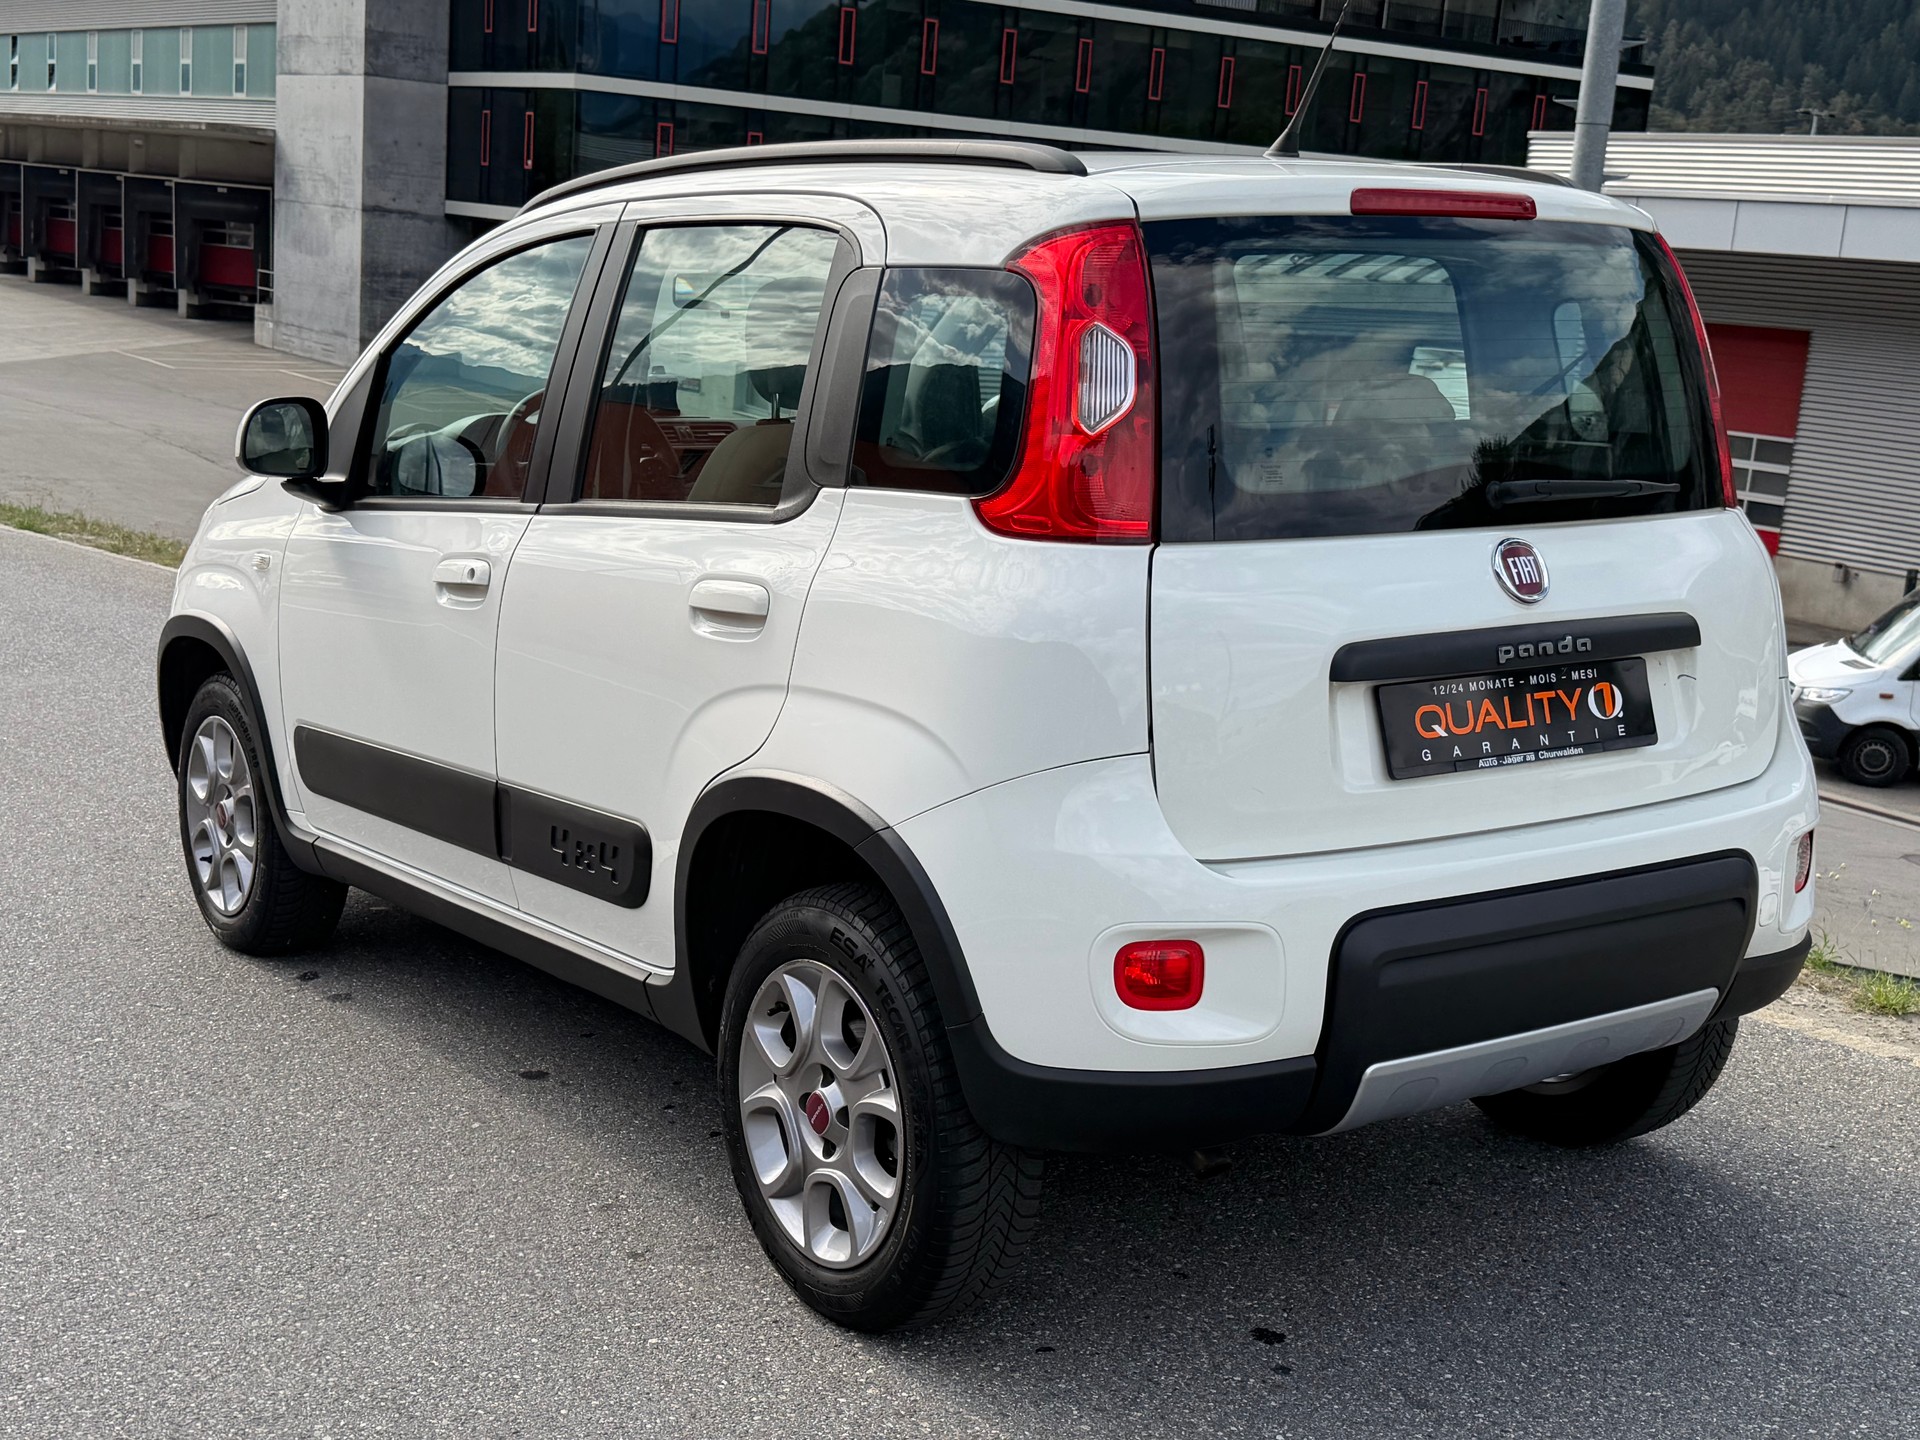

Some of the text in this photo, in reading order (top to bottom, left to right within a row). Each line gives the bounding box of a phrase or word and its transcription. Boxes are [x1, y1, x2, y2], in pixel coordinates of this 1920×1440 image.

[1506, 556, 1540, 585] FIAT
[1498, 635, 1592, 664] panda
[1432, 683, 1464, 696] 12/24
[1469, 677, 1515, 692] MONATE
[1529, 672, 1557, 685] MOIS
[1571, 668, 1598, 680] MESI
[1415, 687, 1582, 739] QUALITY
[1421, 724, 1626, 762] GARANTIE
[1538, 746, 1584, 760] Churwalden
[550, 825, 619, 885] 4x4
